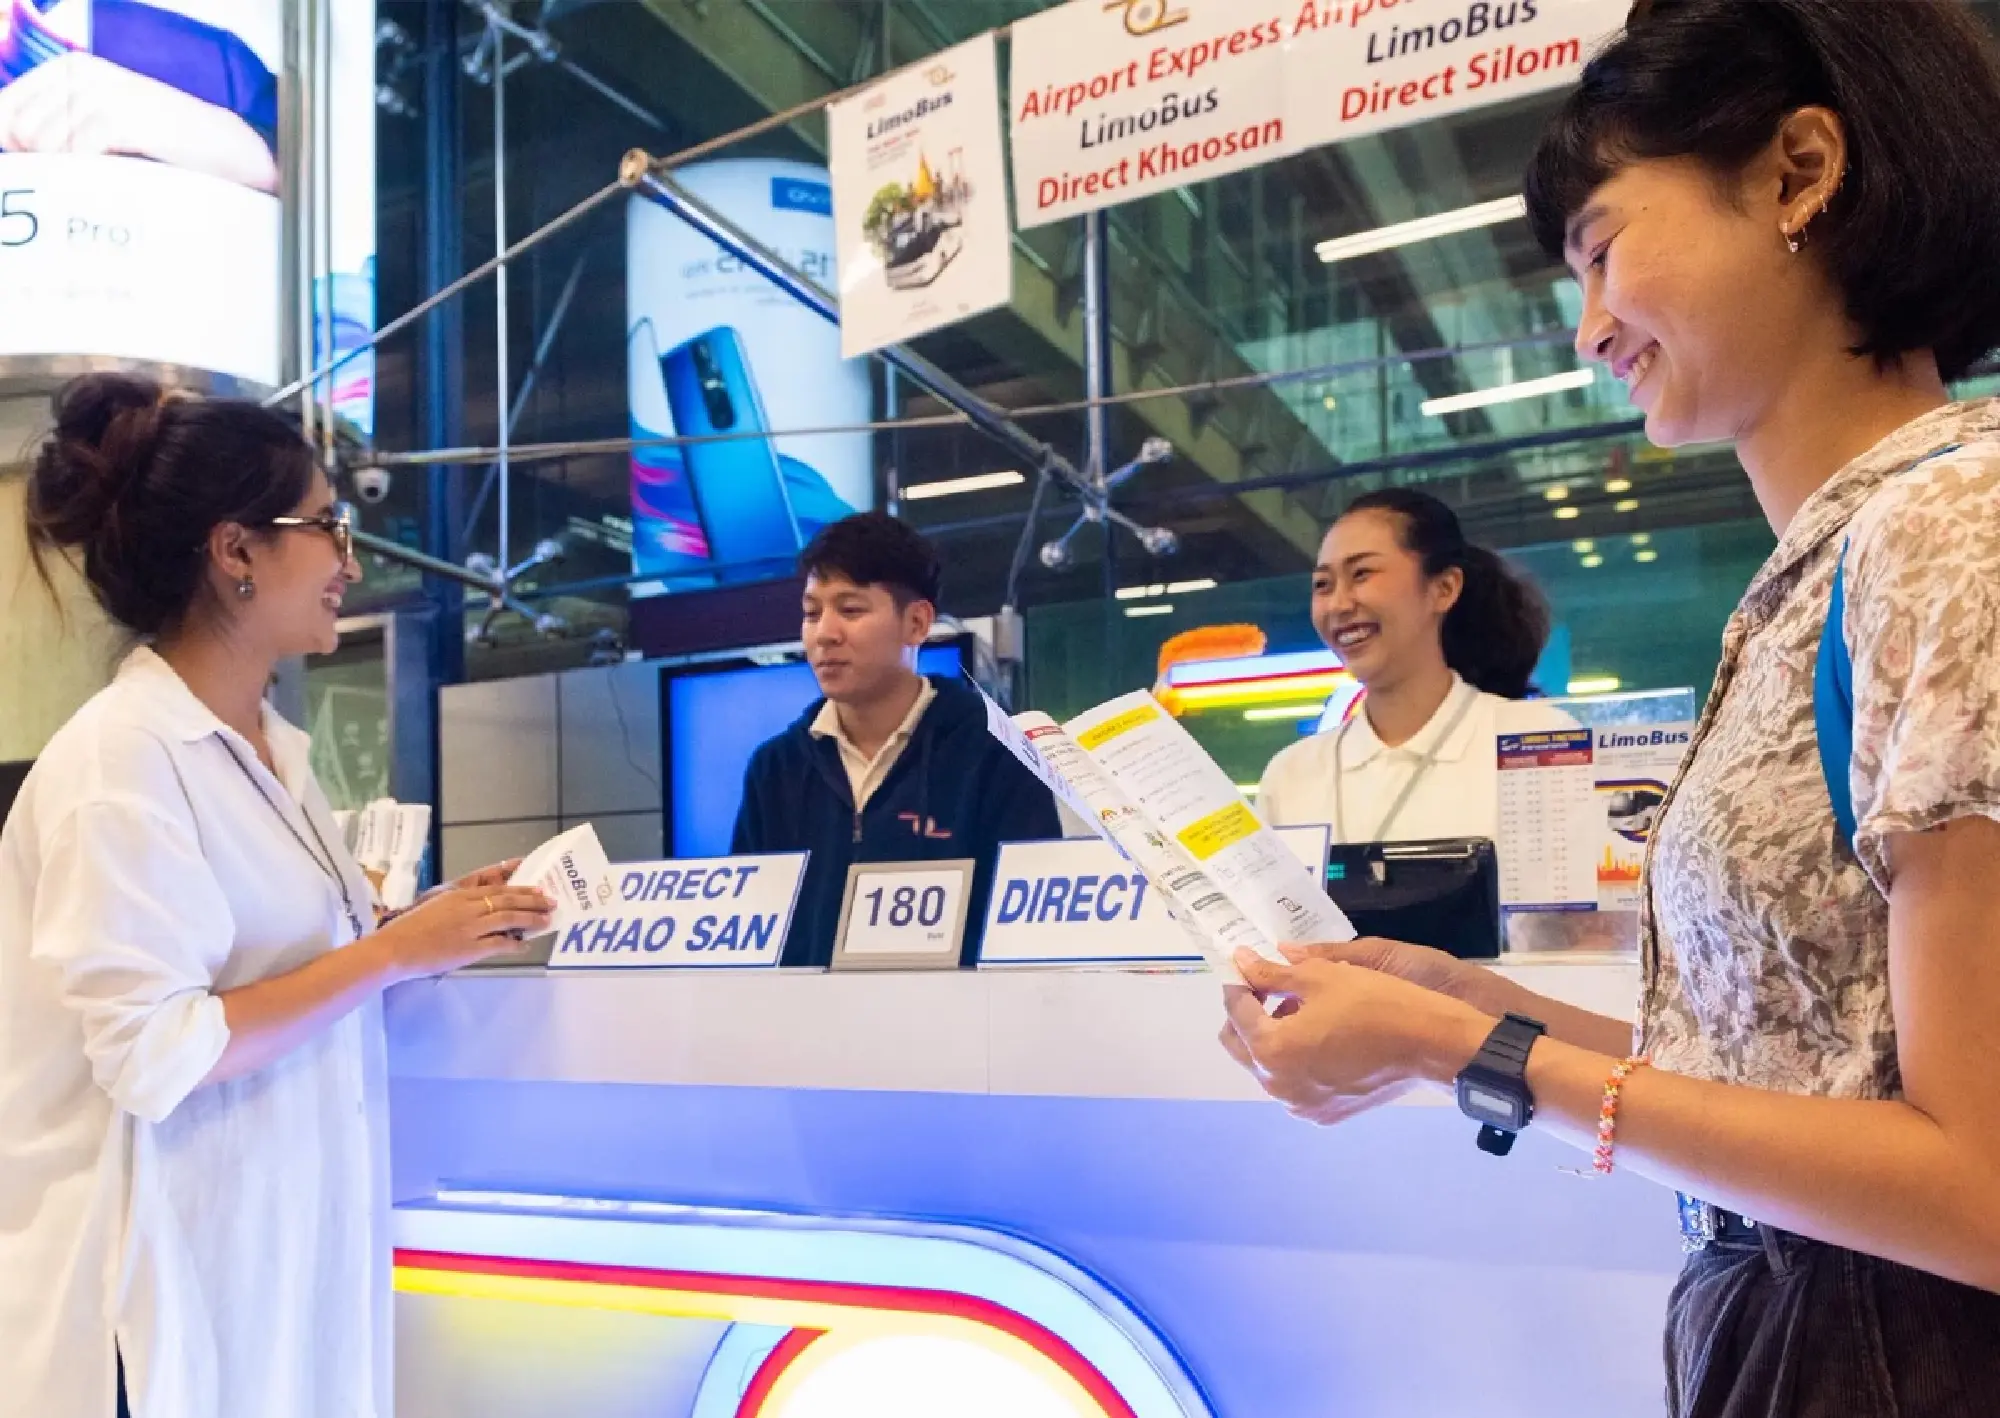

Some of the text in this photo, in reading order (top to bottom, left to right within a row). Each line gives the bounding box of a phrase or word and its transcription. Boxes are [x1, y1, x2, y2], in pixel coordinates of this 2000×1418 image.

[1367, 0, 1537, 63] LimoBus
[1020, 17, 1281, 122] Airport Express
[1340, 37, 1581, 122] Direct Silom
[867, 92, 953, 140] LimoBus
[1080, 87, 1219, 149] LimoBus
[1037, 118, 1283, 209] Direct Khaosan
[67, 216, 131, 247] Pro
[1599, 730, 1689, 749] LimoBus
[620, 865, 760, 900] DIRECT
[865, 885, 946, 927] 180
[997, 873, 1149, 924] DIRECT
[560, 913, 779, 953] KHAO SAN
